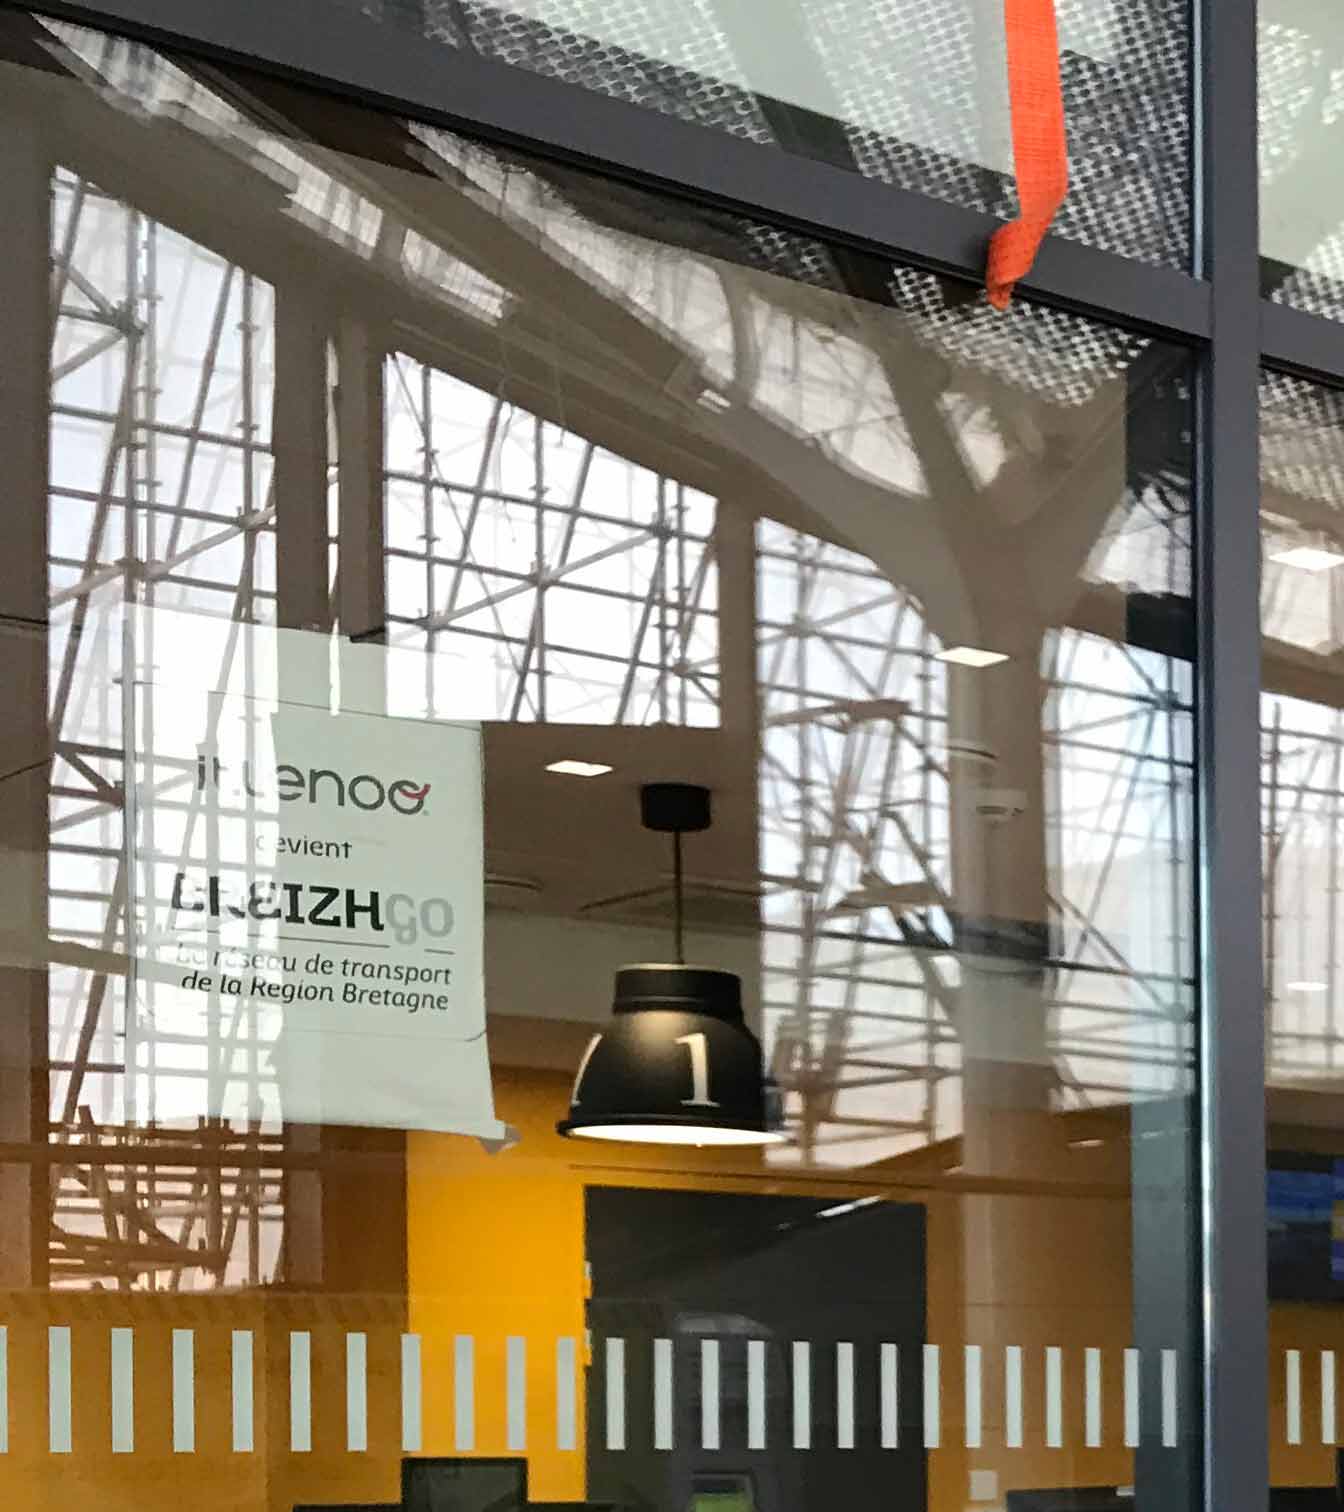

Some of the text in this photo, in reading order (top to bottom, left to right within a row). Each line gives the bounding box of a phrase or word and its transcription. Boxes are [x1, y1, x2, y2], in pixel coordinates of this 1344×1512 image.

[304, 954, 334, 976] de
[341, 957, 451, 984] transport
[182, 970, 212, 992] de
[220, 974, 241, 995] la
[342, 983, 449, 1013] Bretagne
[674, 1032, 721, 1107] 1
